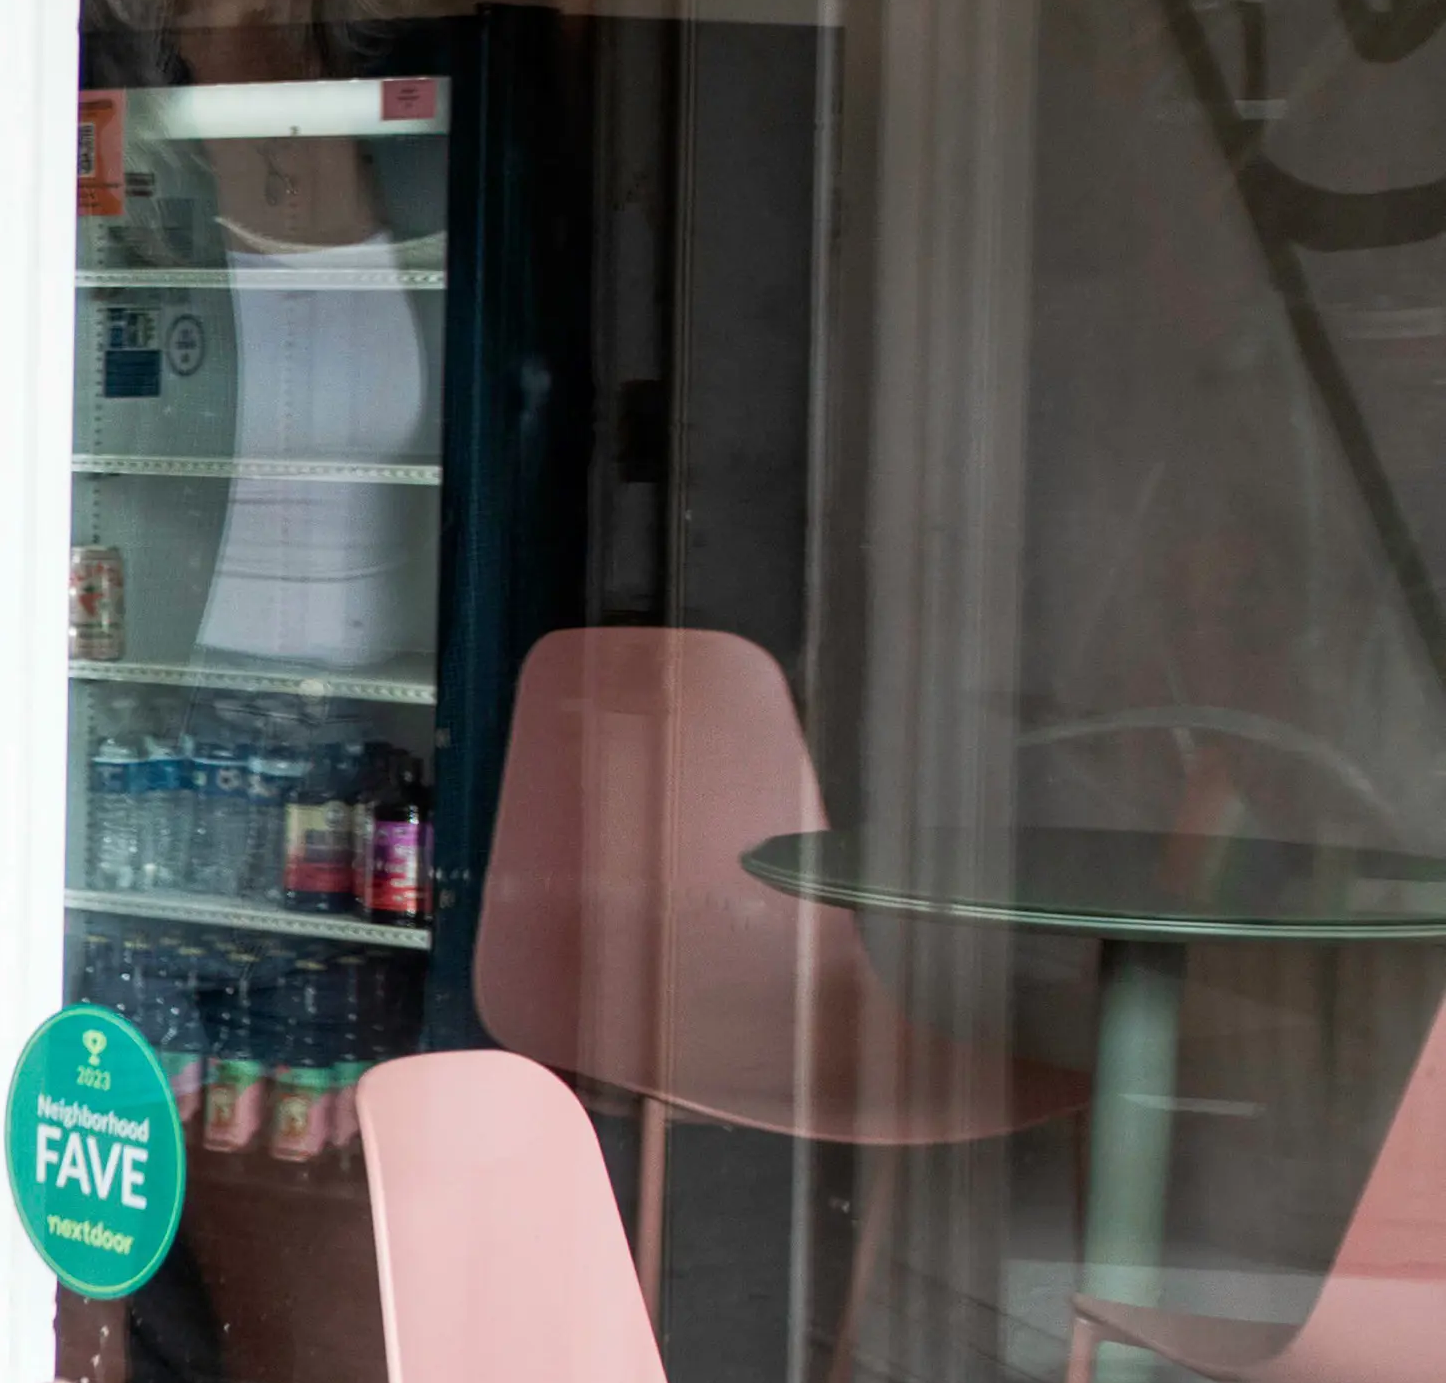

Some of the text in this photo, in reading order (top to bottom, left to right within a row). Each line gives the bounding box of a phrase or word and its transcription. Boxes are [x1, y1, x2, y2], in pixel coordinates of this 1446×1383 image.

[77, 1067, 110, 1091] 2023
[37, 1093, 149, 1142] Neighborhood
[36, 1123, 148, 1210] FAVE
[47, 1214, 134, 1255] nextdoor
